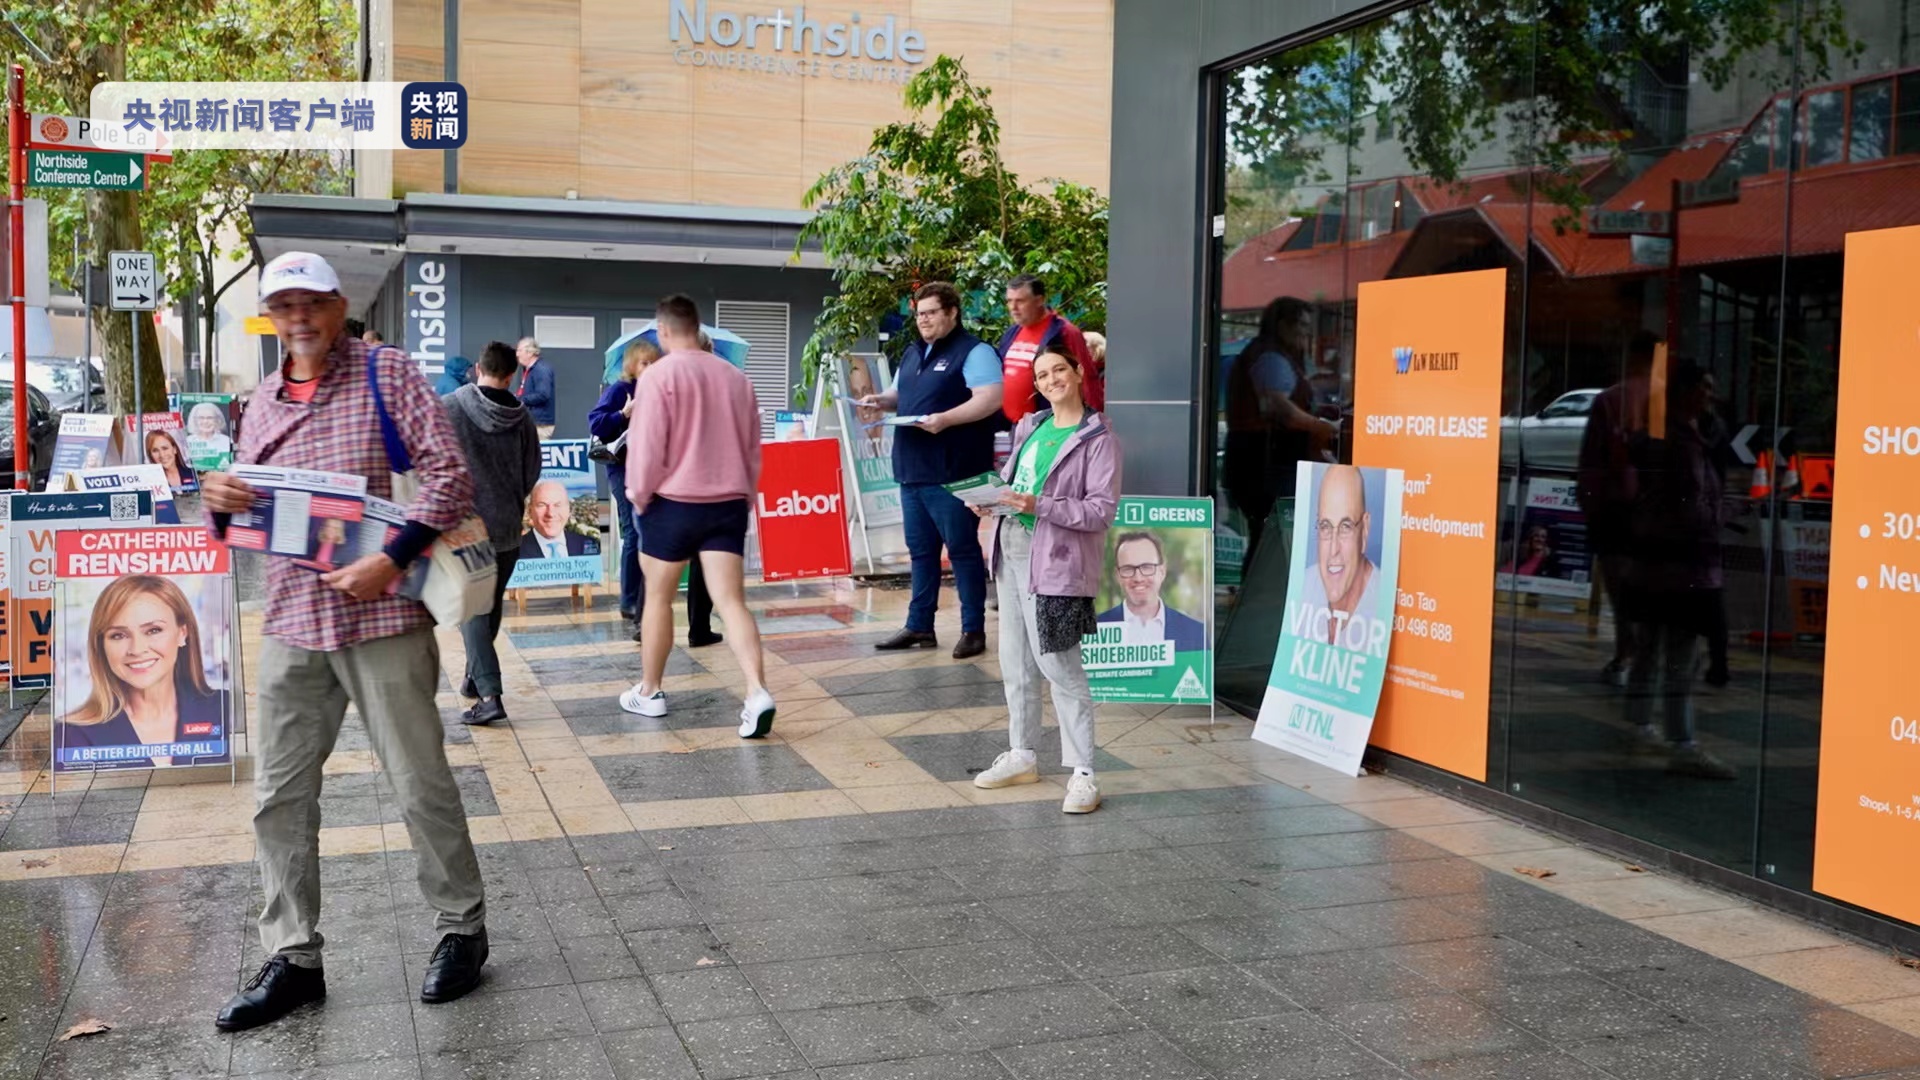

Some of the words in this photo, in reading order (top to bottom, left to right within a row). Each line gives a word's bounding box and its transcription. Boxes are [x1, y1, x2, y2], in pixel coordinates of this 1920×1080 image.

[669, 0, 926, 63] Northside
[673, 48, 821, 77] CONFERENCE
[829, 62, 914, 85] CENTRE
[79, 119, 118, 142] Pole
[35, 152, 88, 169] Northside
[34, 168, 91, 185] Conference
[93, 170, 128, 186] Centre
[116, 257, 149, 271] ONE
[115, 275, 150, 288] WAY
[410, 261, 446, 378] thside
[1428, 352, 1460, 371] REALTY
[1366, 415, 1403, 436] SHOP
[1406, 416, 1436, 437] FOR
[1438, 417, 1488, 439] LEASE
[851, 438, 893, 461] VICTO
[1863, 425, 1920, 456] SHO
[541, 445, 585, 469] ENT
[862, 457, 894, 482] KLIN
[85, 476, 112, 488] VOTE
[112, 475, 119, 486] 1
[122, 476, 140, 485] FOR
[758, 490, 841, 518] Labor
[1148, 507, 1206, 522] GREENS
[1401, 510, 1485, 539] development
[80, 530, 208, 551] CATHERINE
[69, 550, 217, 576] RENSHAW
[517, 559, 572, 573] Delivering
[574, 560, 589, 569] for
[514, 573, 533, 584] our
[533, 570, 595, 582] community
[1416, 591, 1437, 613] Tao
[1081, 626, 1122, 646] DAVID
[1288, 600, 1387, 659] VICTOR
[1406, 617, 1429, 638] 496
[1430, 621, 1453, 643] 688
[1080, 643, 1167, 666] SHOEBRIDGE
[1119, 669, 1153, 677] CANDIDATE
[1289, 638, 1368, 695] KLINE
[186, 723, 211, 735] Labor
[1305, 705, 1336, 741] TNL
[1890, 716, 1920, 745] 04
[72, 749, 81, 761] A
[82, 747, 124, 761] BETTER
[126, 745, 168, 758] FUTURE
[170, 744, 193, 756] FOR
[194, 742, 213, 754] ALL
[1895, 805, 1913, 819] 1-5
